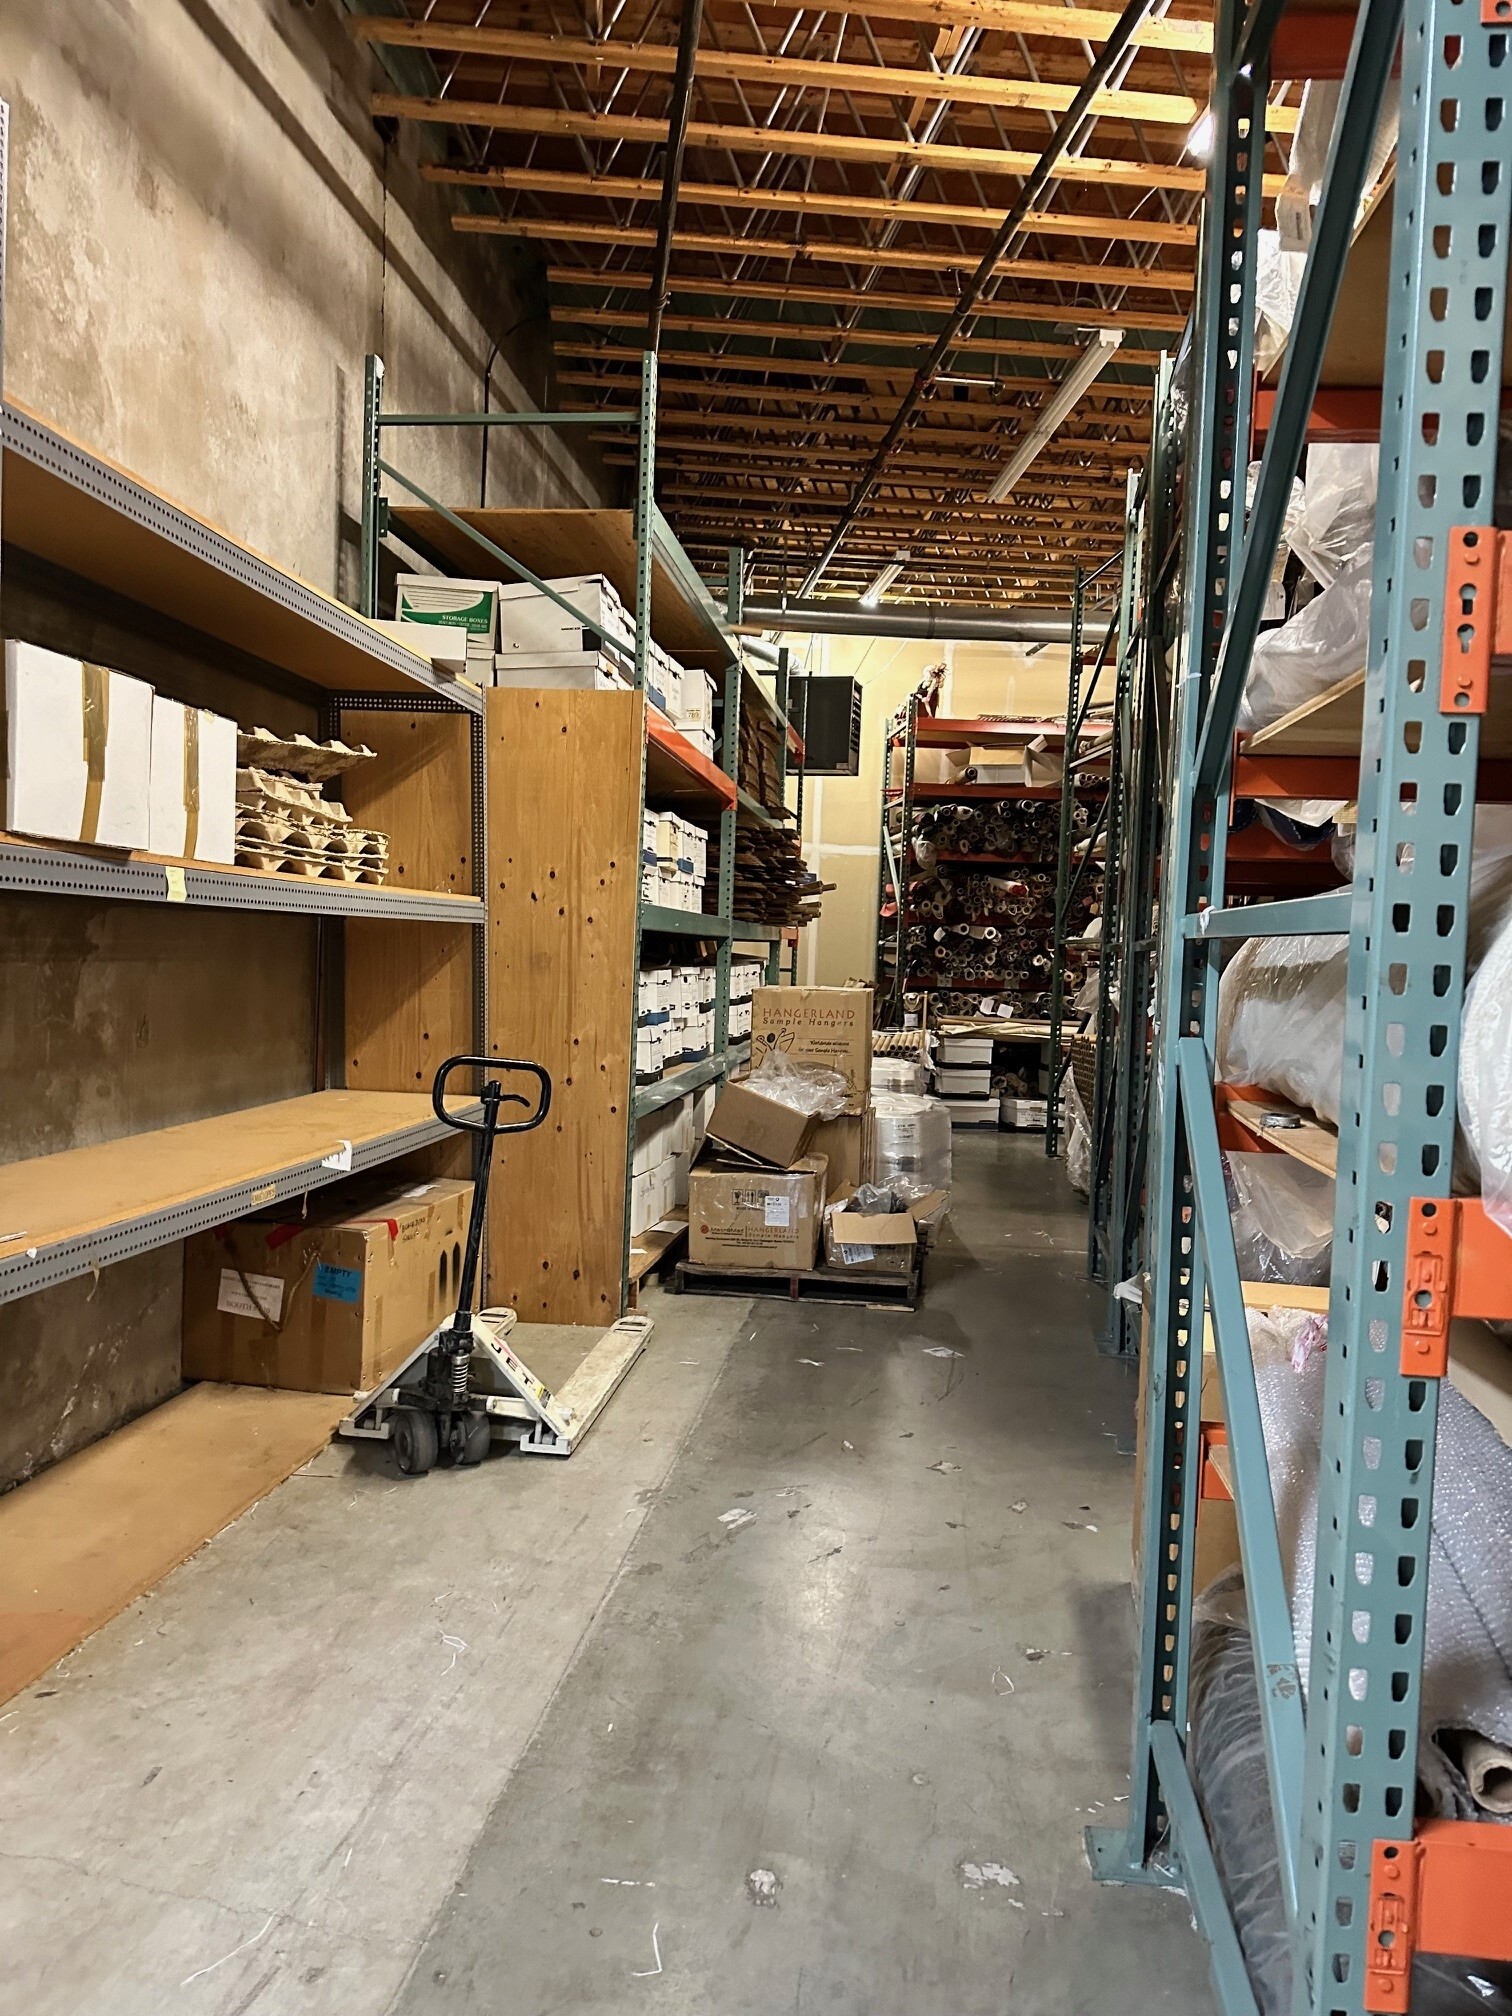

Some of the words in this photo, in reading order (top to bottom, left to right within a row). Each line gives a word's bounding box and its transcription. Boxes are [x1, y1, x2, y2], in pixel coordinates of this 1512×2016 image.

[442, 614, 468, 622] STORAGE
[763, 1008, 855, 1019] HANGERLAND
[763, 1017, 802, 1026] Sample
[325, 1265, 352, 1278] EMPTY
[490, 1342, 533, 1386] JET
